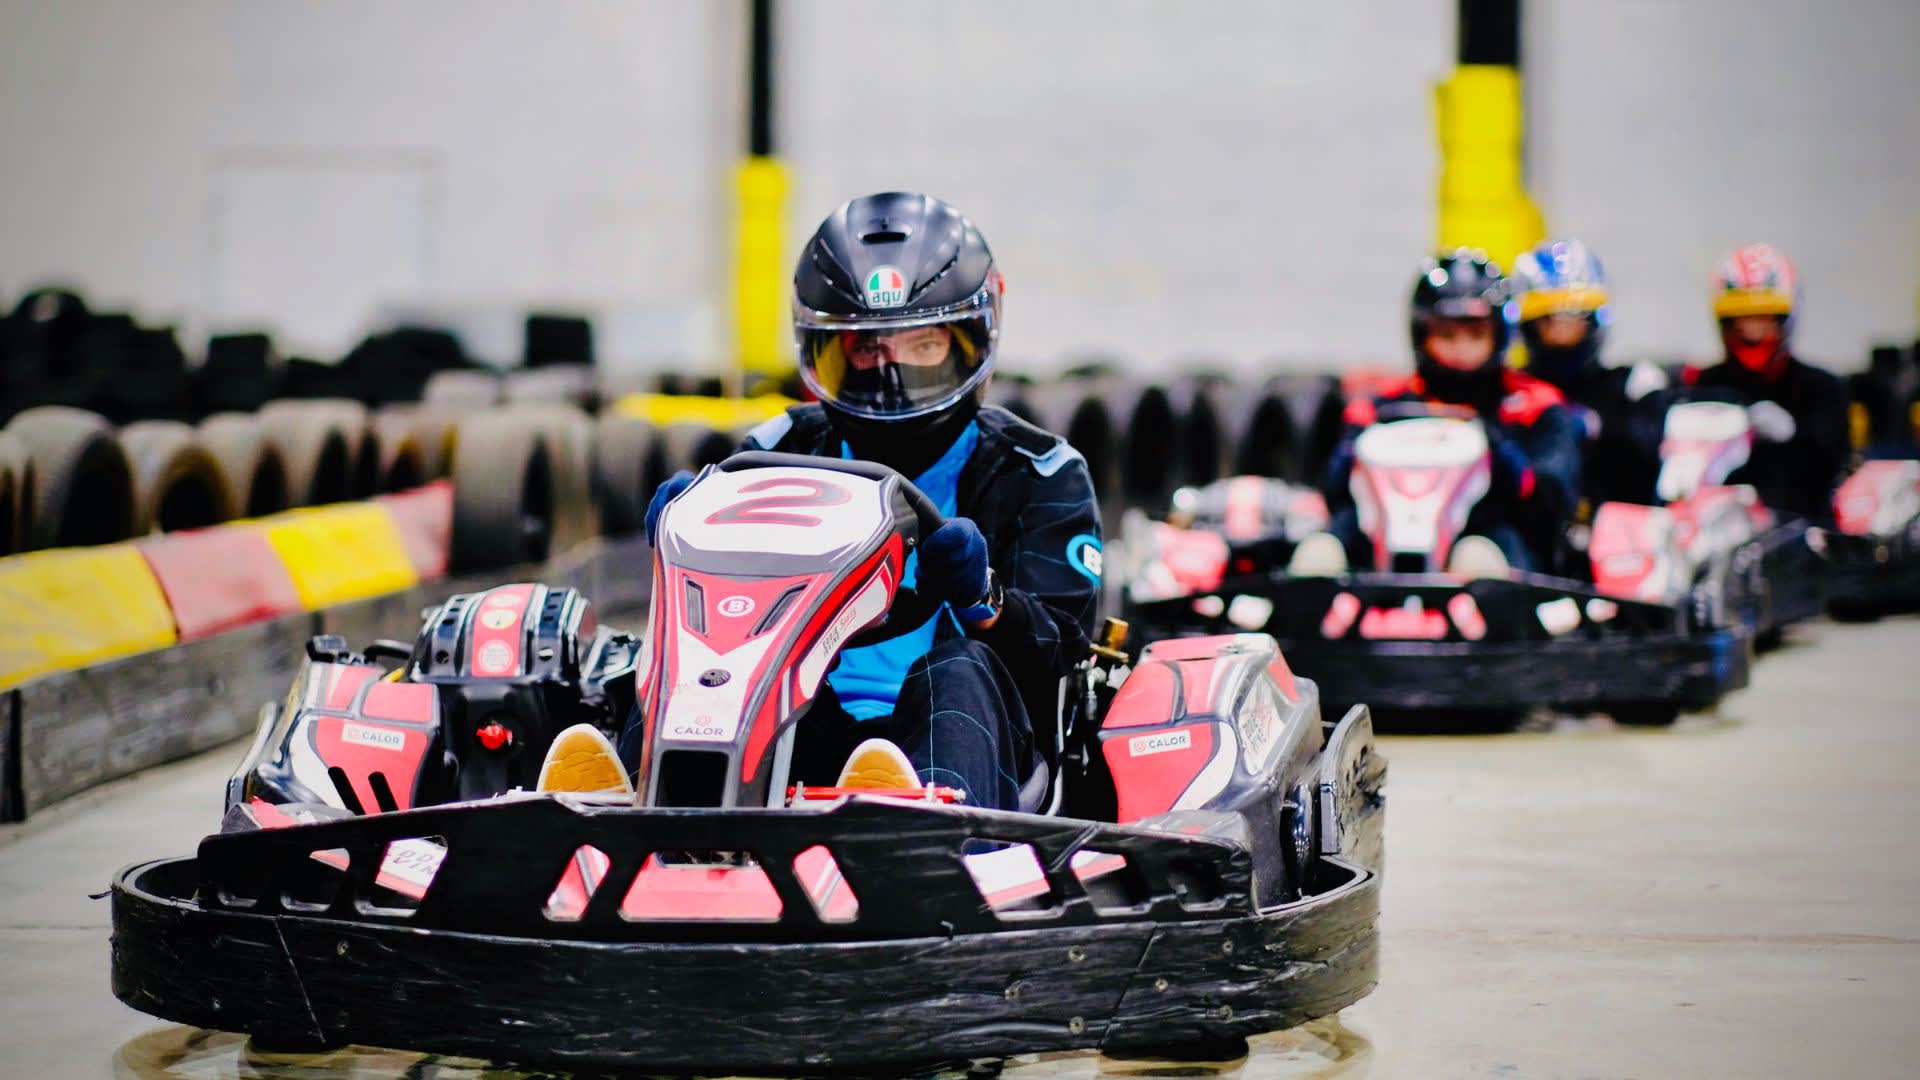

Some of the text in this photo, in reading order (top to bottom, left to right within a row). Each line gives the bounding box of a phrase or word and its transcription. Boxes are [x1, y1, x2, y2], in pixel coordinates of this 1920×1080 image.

[704, 477, 853, 527] 2
[674, 726, 724, 736] CALOR
[362, 732, 400, 745] CALOR
[1148, 735, 1187, 749] CALOR
